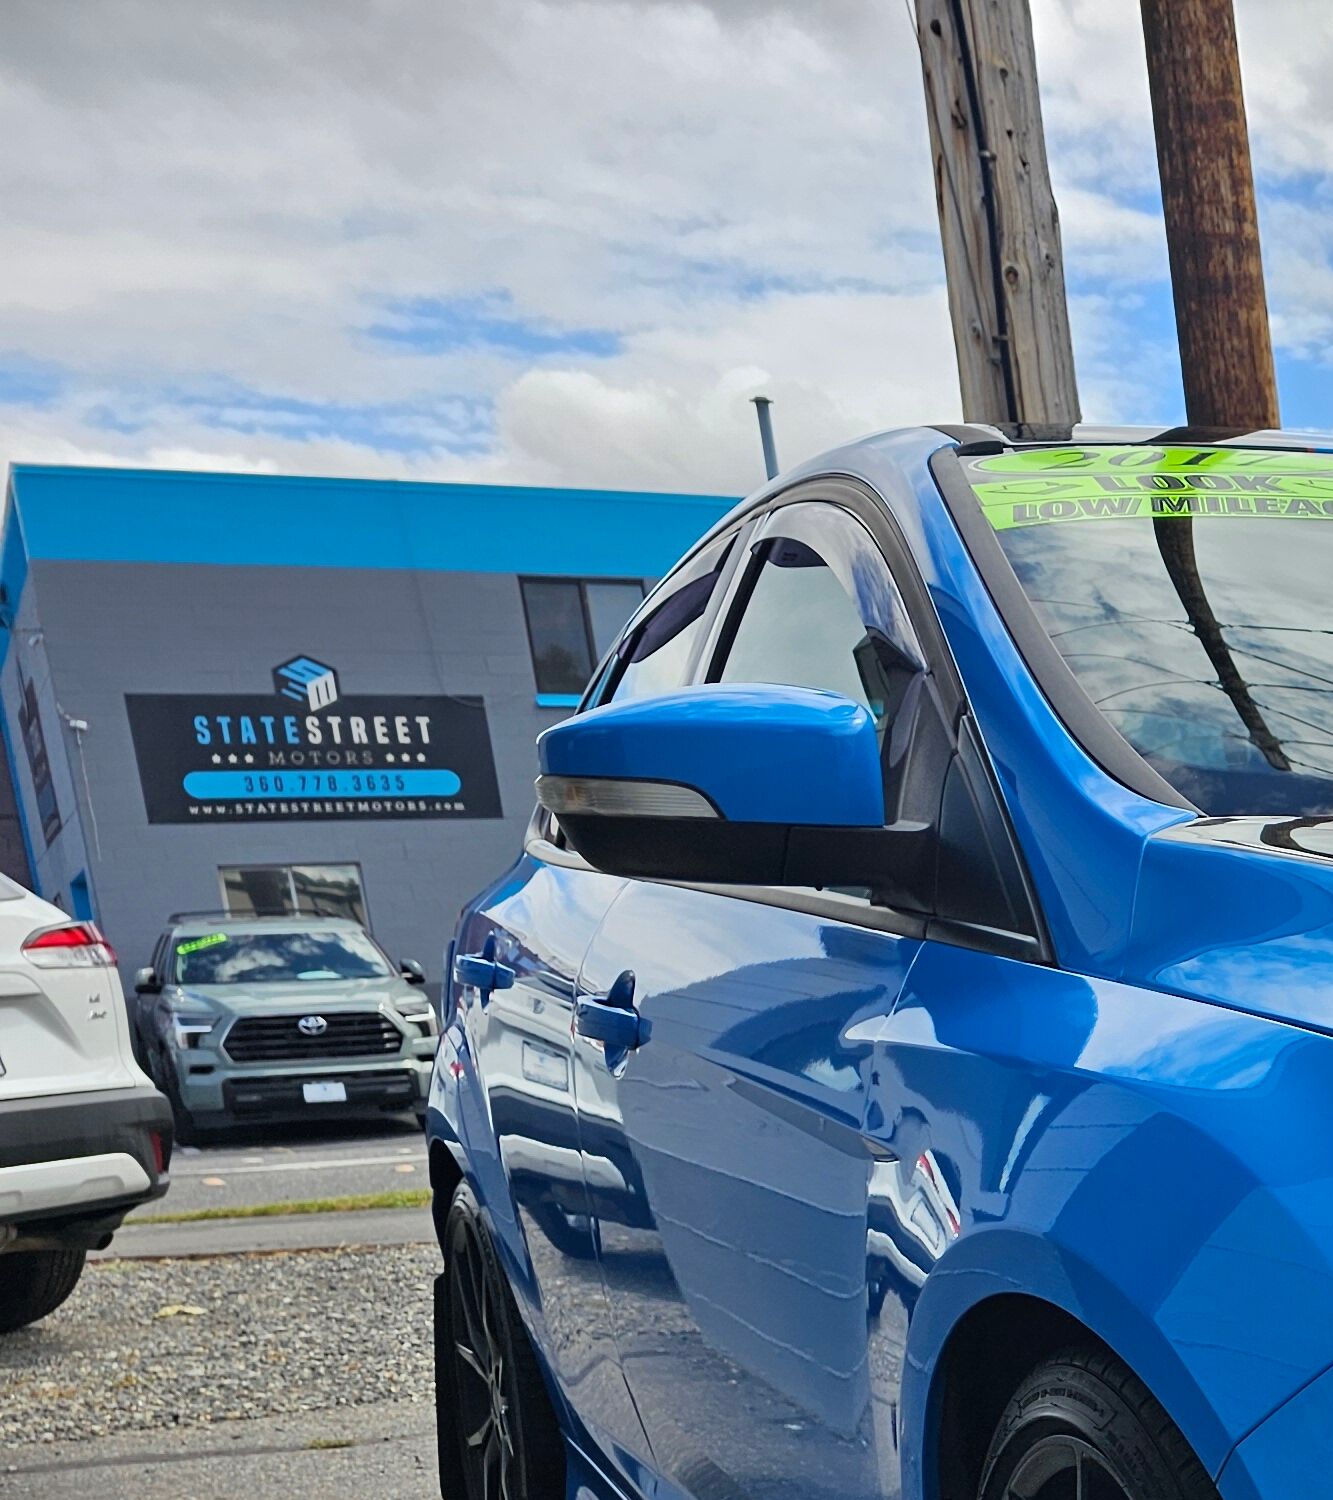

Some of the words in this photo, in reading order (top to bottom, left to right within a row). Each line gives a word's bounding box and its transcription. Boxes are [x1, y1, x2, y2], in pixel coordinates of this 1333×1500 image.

[1040, 451, 1283, 470] 2017
[1093, 475, 1288, 493] LOOK
[1013, 497, 1142, 522] LOW
[268, 751, 373, 765] MOTORS
[244, 776, 405, 792] 360.778.3635
